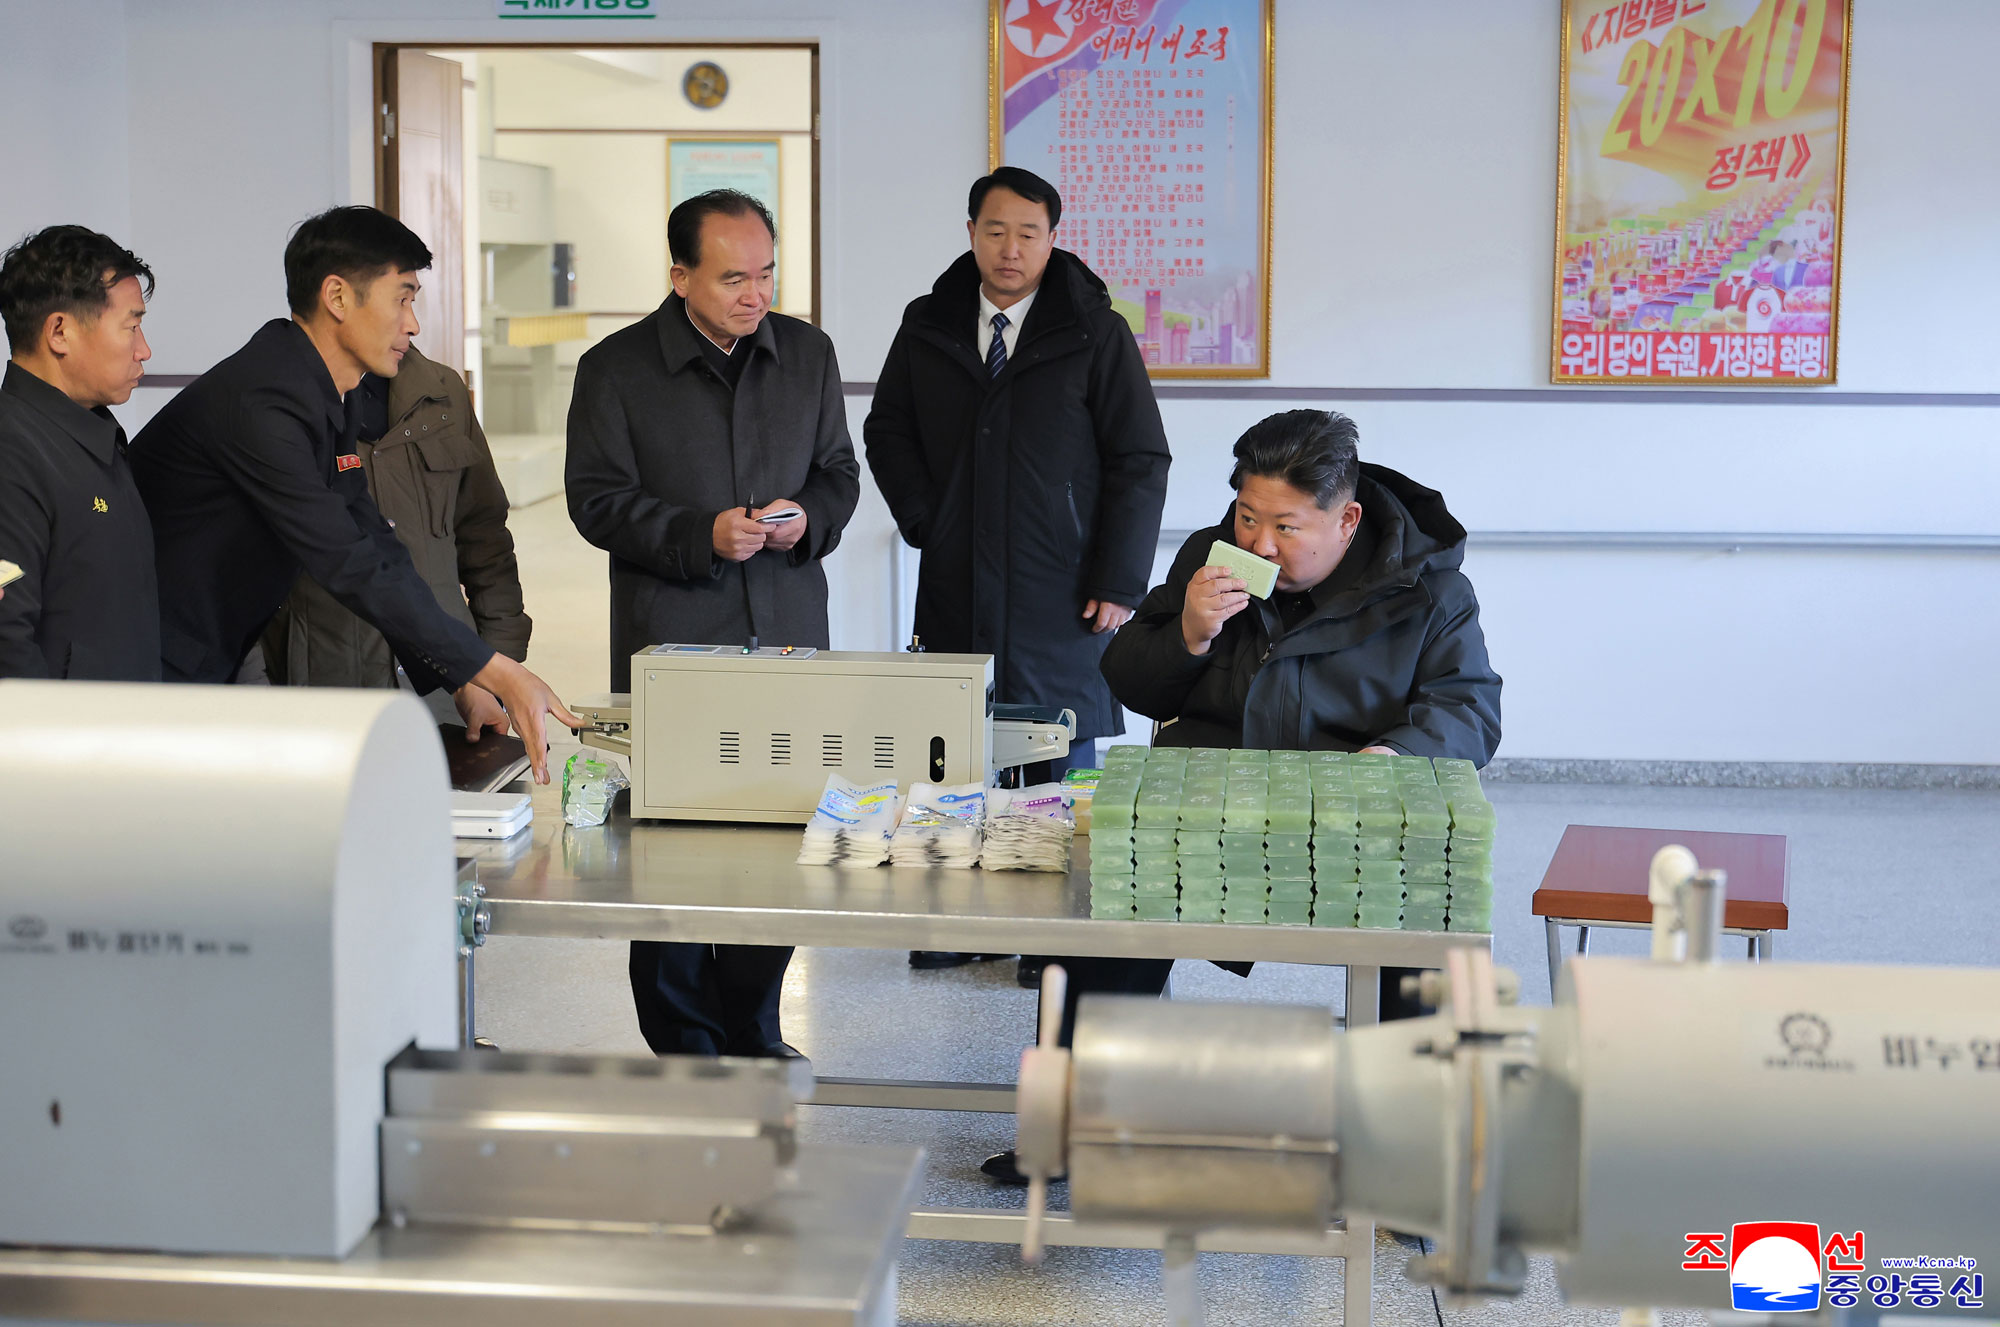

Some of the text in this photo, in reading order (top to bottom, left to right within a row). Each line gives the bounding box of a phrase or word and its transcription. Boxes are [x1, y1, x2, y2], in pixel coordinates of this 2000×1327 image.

[1093, 24, 1229, 64] 어머니 내 조국
[1561, 334, 1602, 376] 우리
[1608, 335, 1653, 376] 당의
[1710, 335, 1775, 377] 거창한
[1780, 335, 1829, 377] 혁명!
